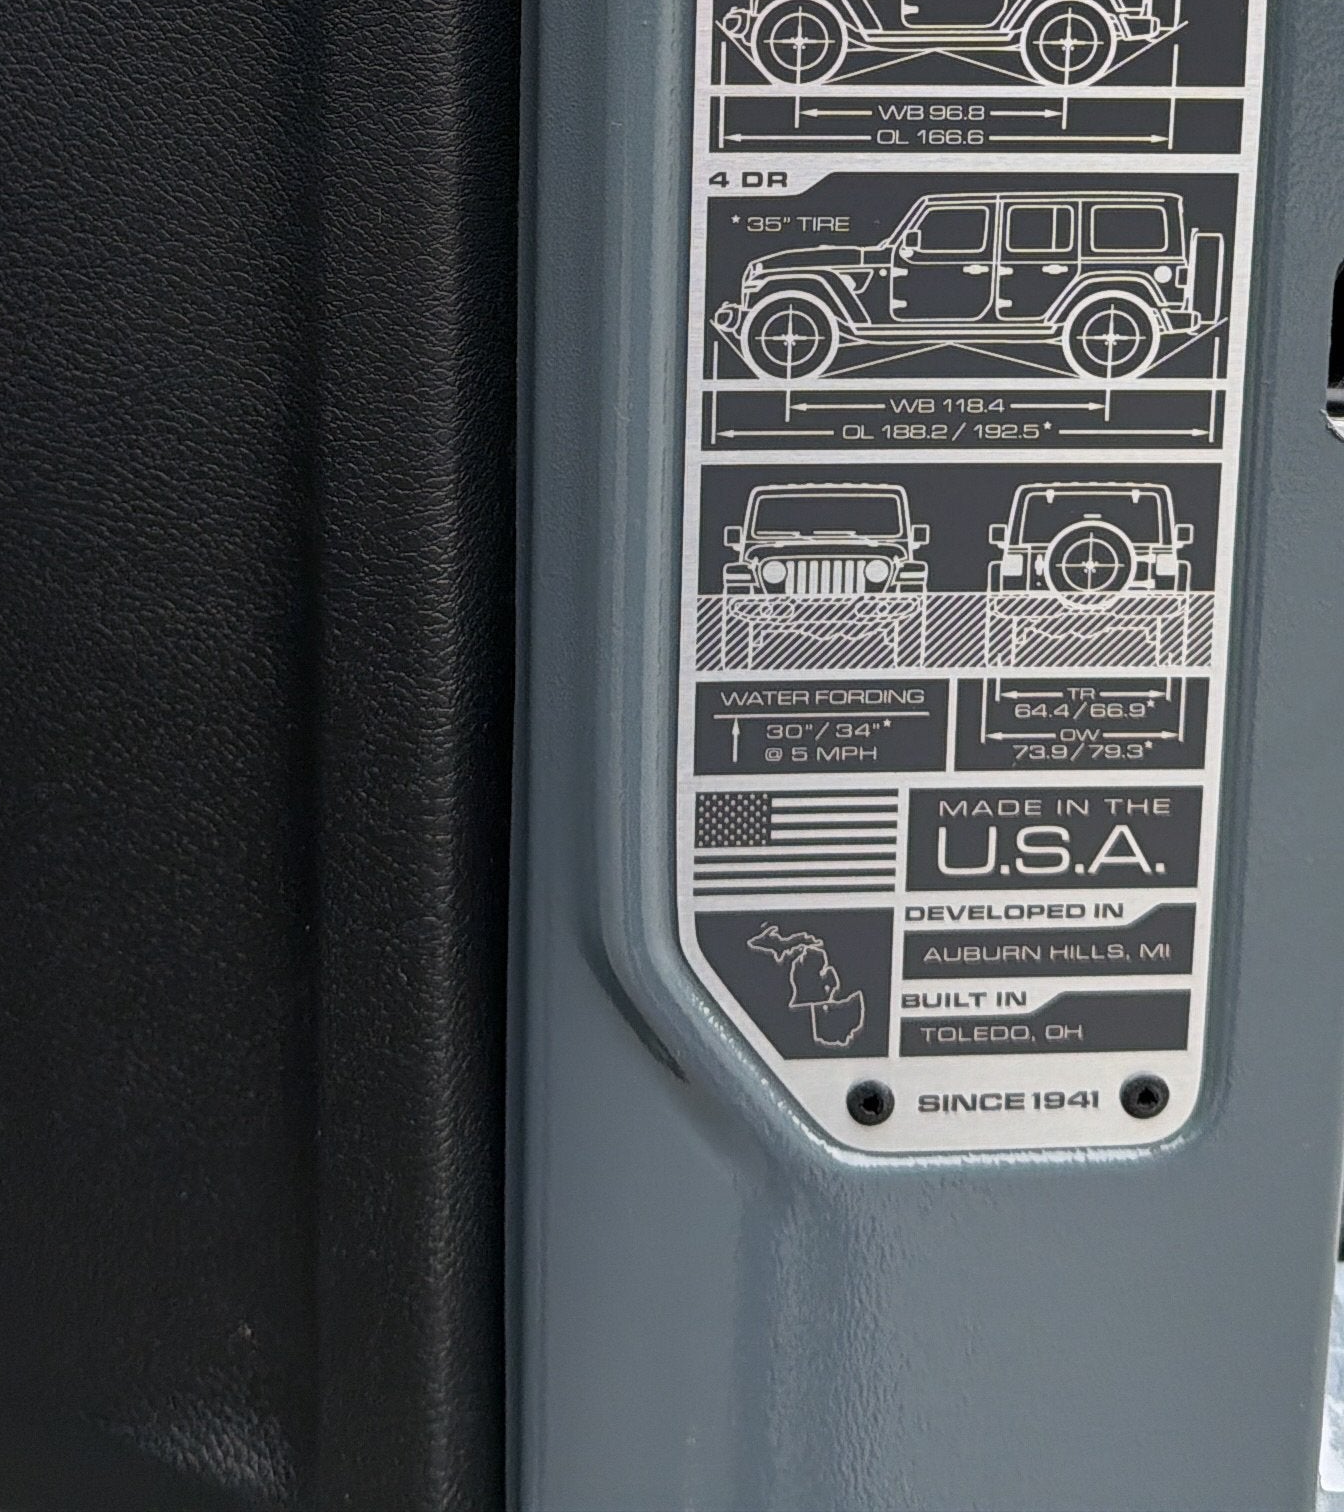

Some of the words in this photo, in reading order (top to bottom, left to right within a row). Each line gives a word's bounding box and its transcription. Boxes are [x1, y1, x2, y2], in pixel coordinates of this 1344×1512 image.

[877, 104, 925, 121] WB
[929, 105, 985, 121] 96.8
[876, 129, 910, 145] OL
[917, 129, 984, 145] 166.6
[708, 171, 730, 188] 4
[741, 171, 788, 188] DR
[796, 216, 850, 232] TIRE
[889, 398, 935, 414] WB
[942, 398, 1005, 414] 118.4
[842, 424, 875, 440] OL
[720, 690, 810, 707] WATER
[815, 688, 926, 706] FORDING
[1066, 687, 1097, 702] TR
[1059, 728, 1102, 743] OW
[764, 747, 783, 762] @
[791, 746, 808, 762] 5
[815, 745, 877, 762] MPH
[939, 799, 1042, 817] MADE
[1057, 799, 1089, 815] IN
[1103, 798, 1171, 815] THE
[937, 824, 1166, 876] U.S.A.
[904, 903, 1087, 923] DEVELOPED
[1093, 902, 1125, 920] IN
[923, 945, 1041, 962] AUBURN
[1049, 943, 1130, 961] HILLS,
[1139, 943, 1170, 959] MI
[900, 991, 988, 1010] BUILT
[996, 990, 1028, 1008] IN
[920, 1025, 1036, 1043] TOLEDO,
[1045, 1024, 1083, 1040] OH
[917, 1092, 1025, 1114] SINCE
[1032, 1090, 1099, 1110] 1941
